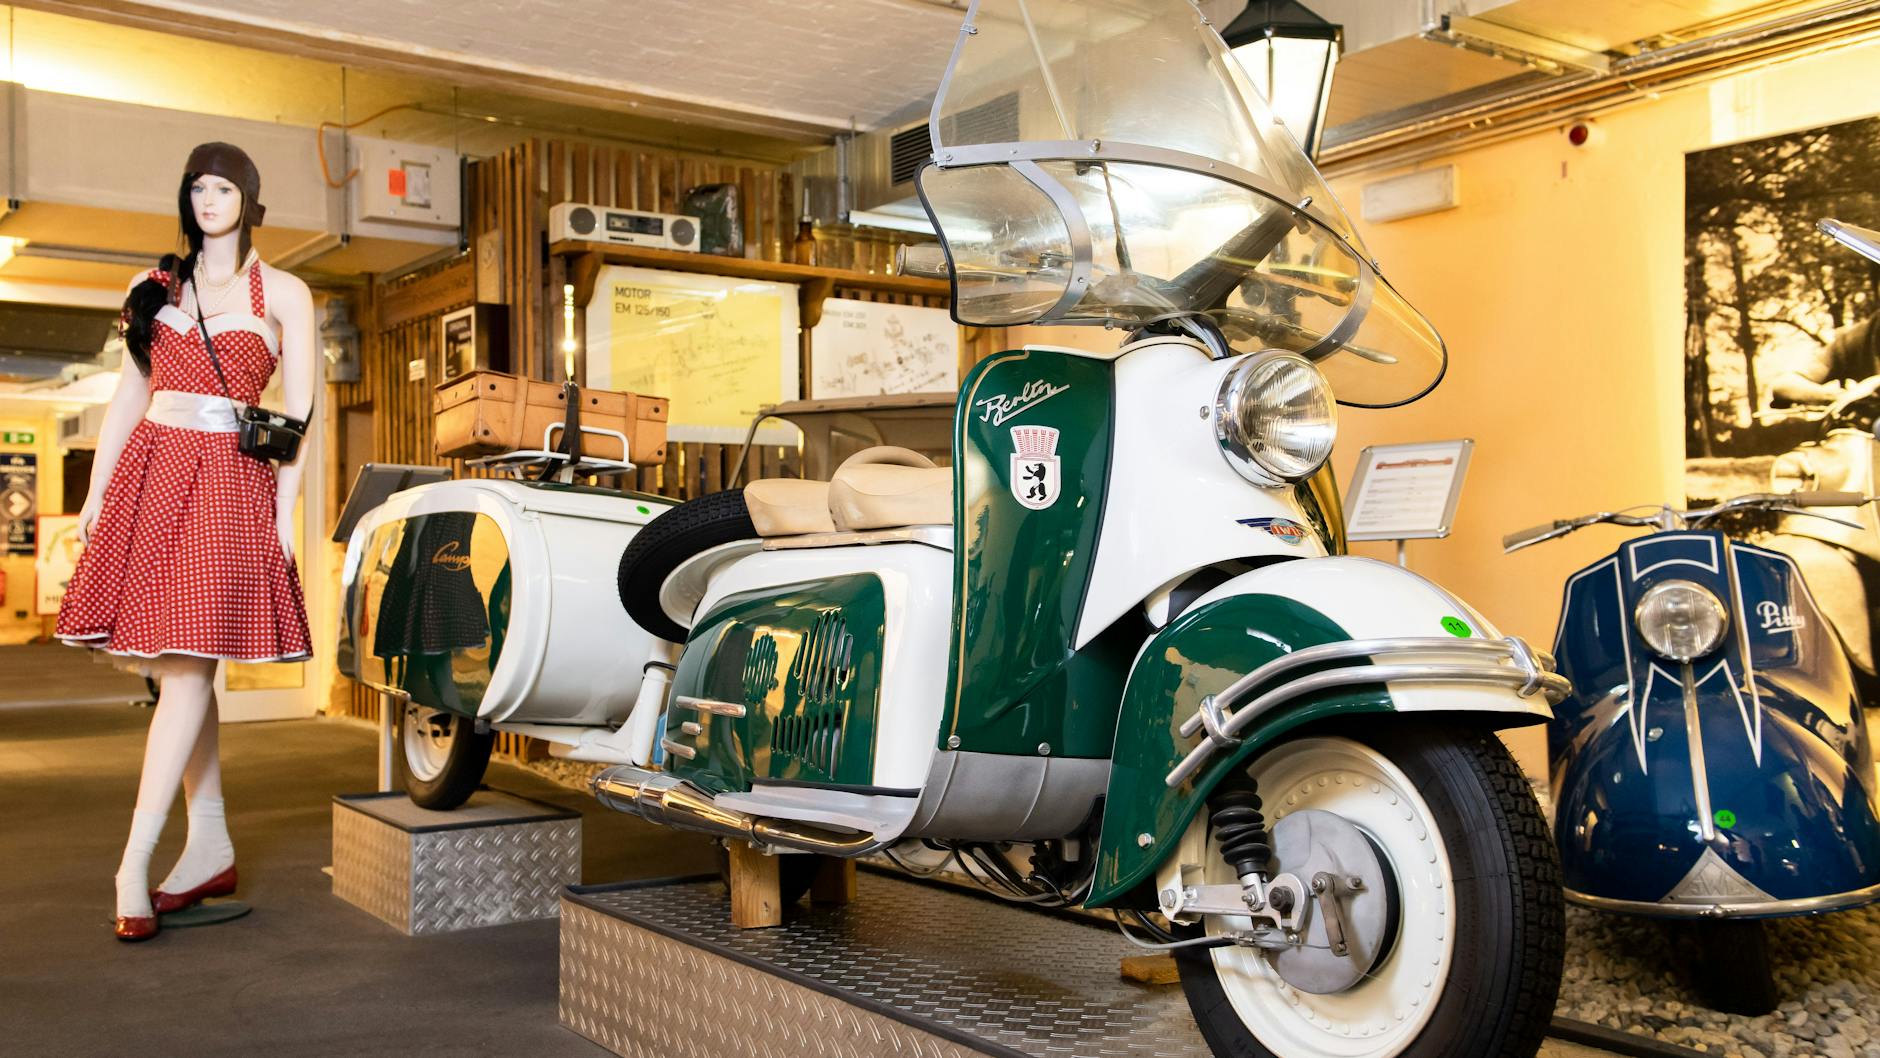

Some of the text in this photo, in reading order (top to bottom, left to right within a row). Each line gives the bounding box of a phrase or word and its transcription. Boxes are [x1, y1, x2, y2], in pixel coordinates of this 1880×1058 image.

[615, 286, 652, 299] MOTOR
[615, 302, 631, 314] EM
[976, 379, 1070, 427] Berlin
[1448, 622, 1464, 631] 11
